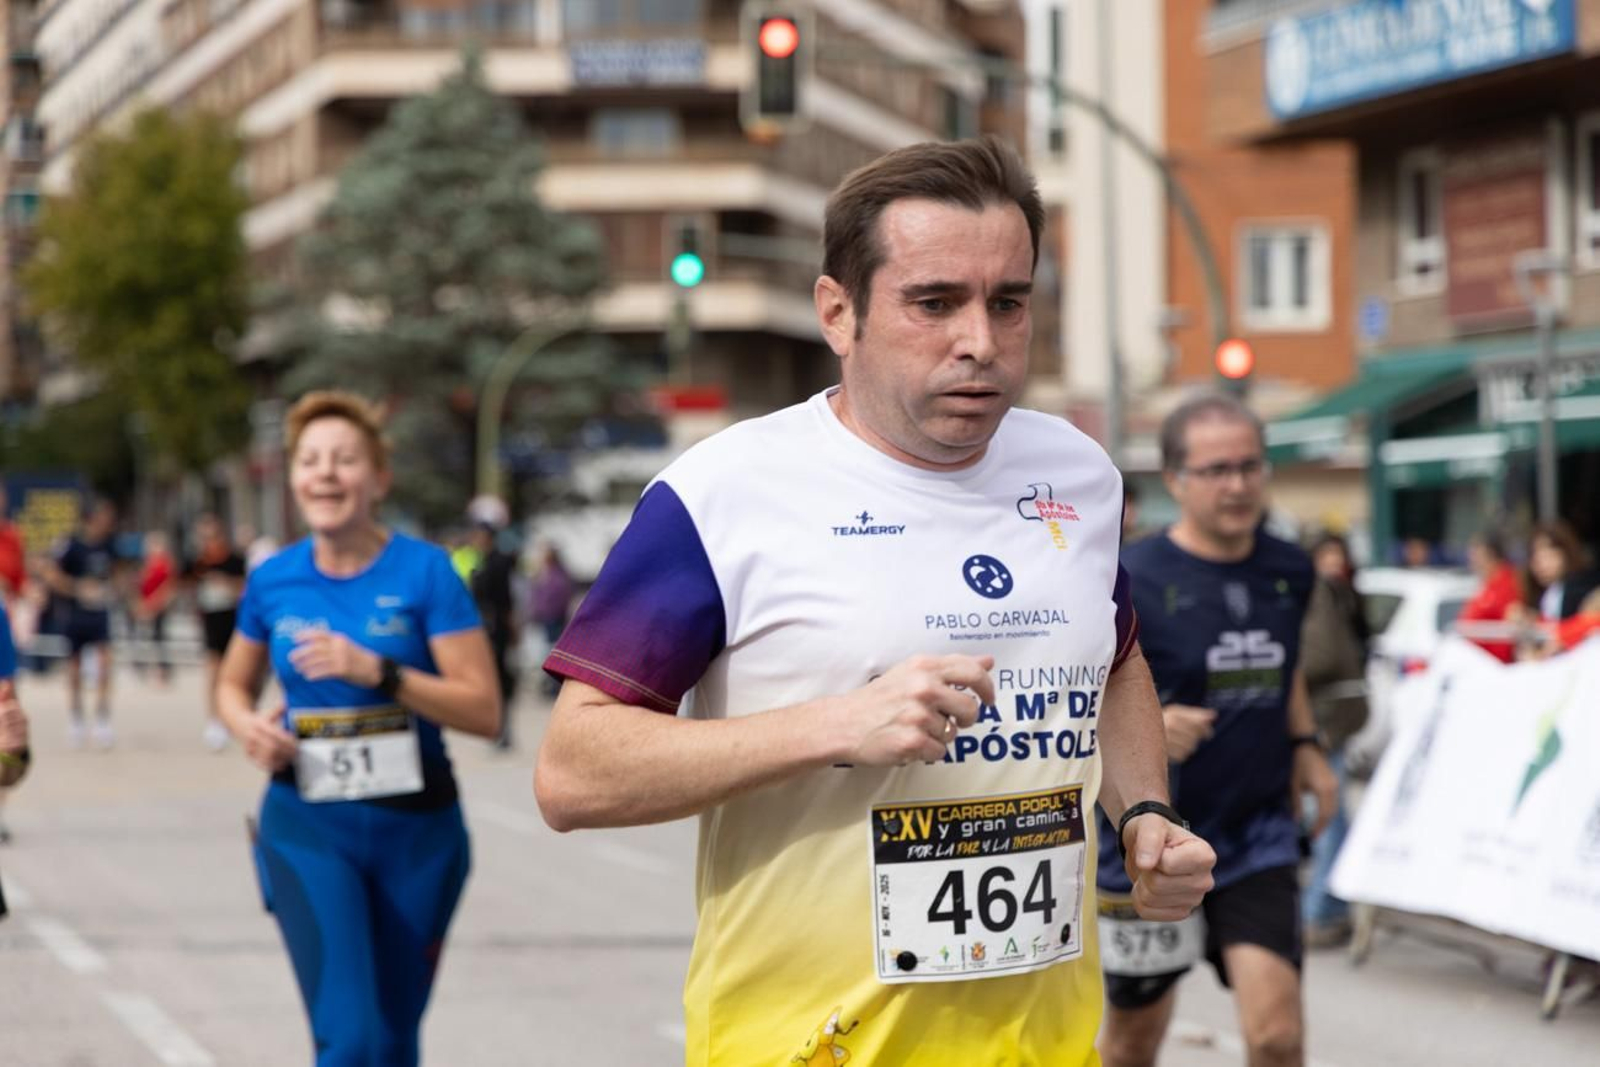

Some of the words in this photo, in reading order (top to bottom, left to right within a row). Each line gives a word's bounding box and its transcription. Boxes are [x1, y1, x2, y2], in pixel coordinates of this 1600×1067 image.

[832, 524, 906, 536] TEAMERGY
[925, 612, 982, 629] PABLO
[987, 609, 1070, 628] CARVAJAL
[1207, 631, 1286, 671] 25
[1000, 665, 1107, 690] RUNNING
[1069, 690, 1099, 719] DE
[332, 747, 373, 777] 51
[937, 802, 1017, 822] CARRERA
[1020, 791, 1078, 814] POPULR
[937, 823, 950, 839] y
[960, 819, 1006, 838] gran
[907, 844, 934, 859] POR
[935, 843, 955, 857] LA
[992, 838, 1010, 852] LA
[927, 859, 1057, 935] 464
